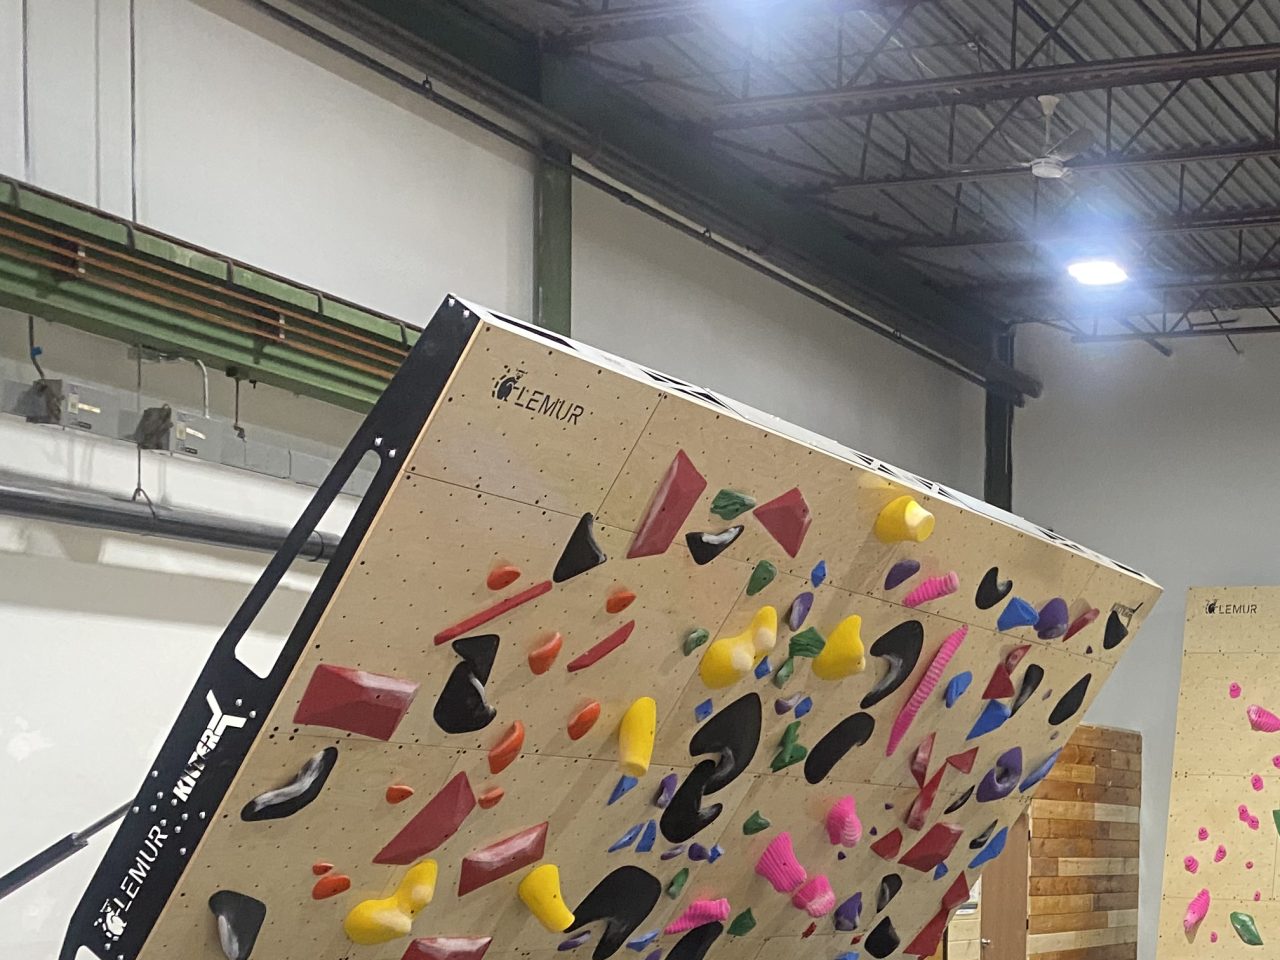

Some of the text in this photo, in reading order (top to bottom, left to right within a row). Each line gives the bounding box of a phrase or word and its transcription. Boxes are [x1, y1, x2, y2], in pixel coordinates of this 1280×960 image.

[513, 386, 585, 426] LEMUR
[1218, 603, 1258, 615] LEMUR
[173, 726, 222, 802] KILTER
[113, 825, 169, 912] LEMUR
